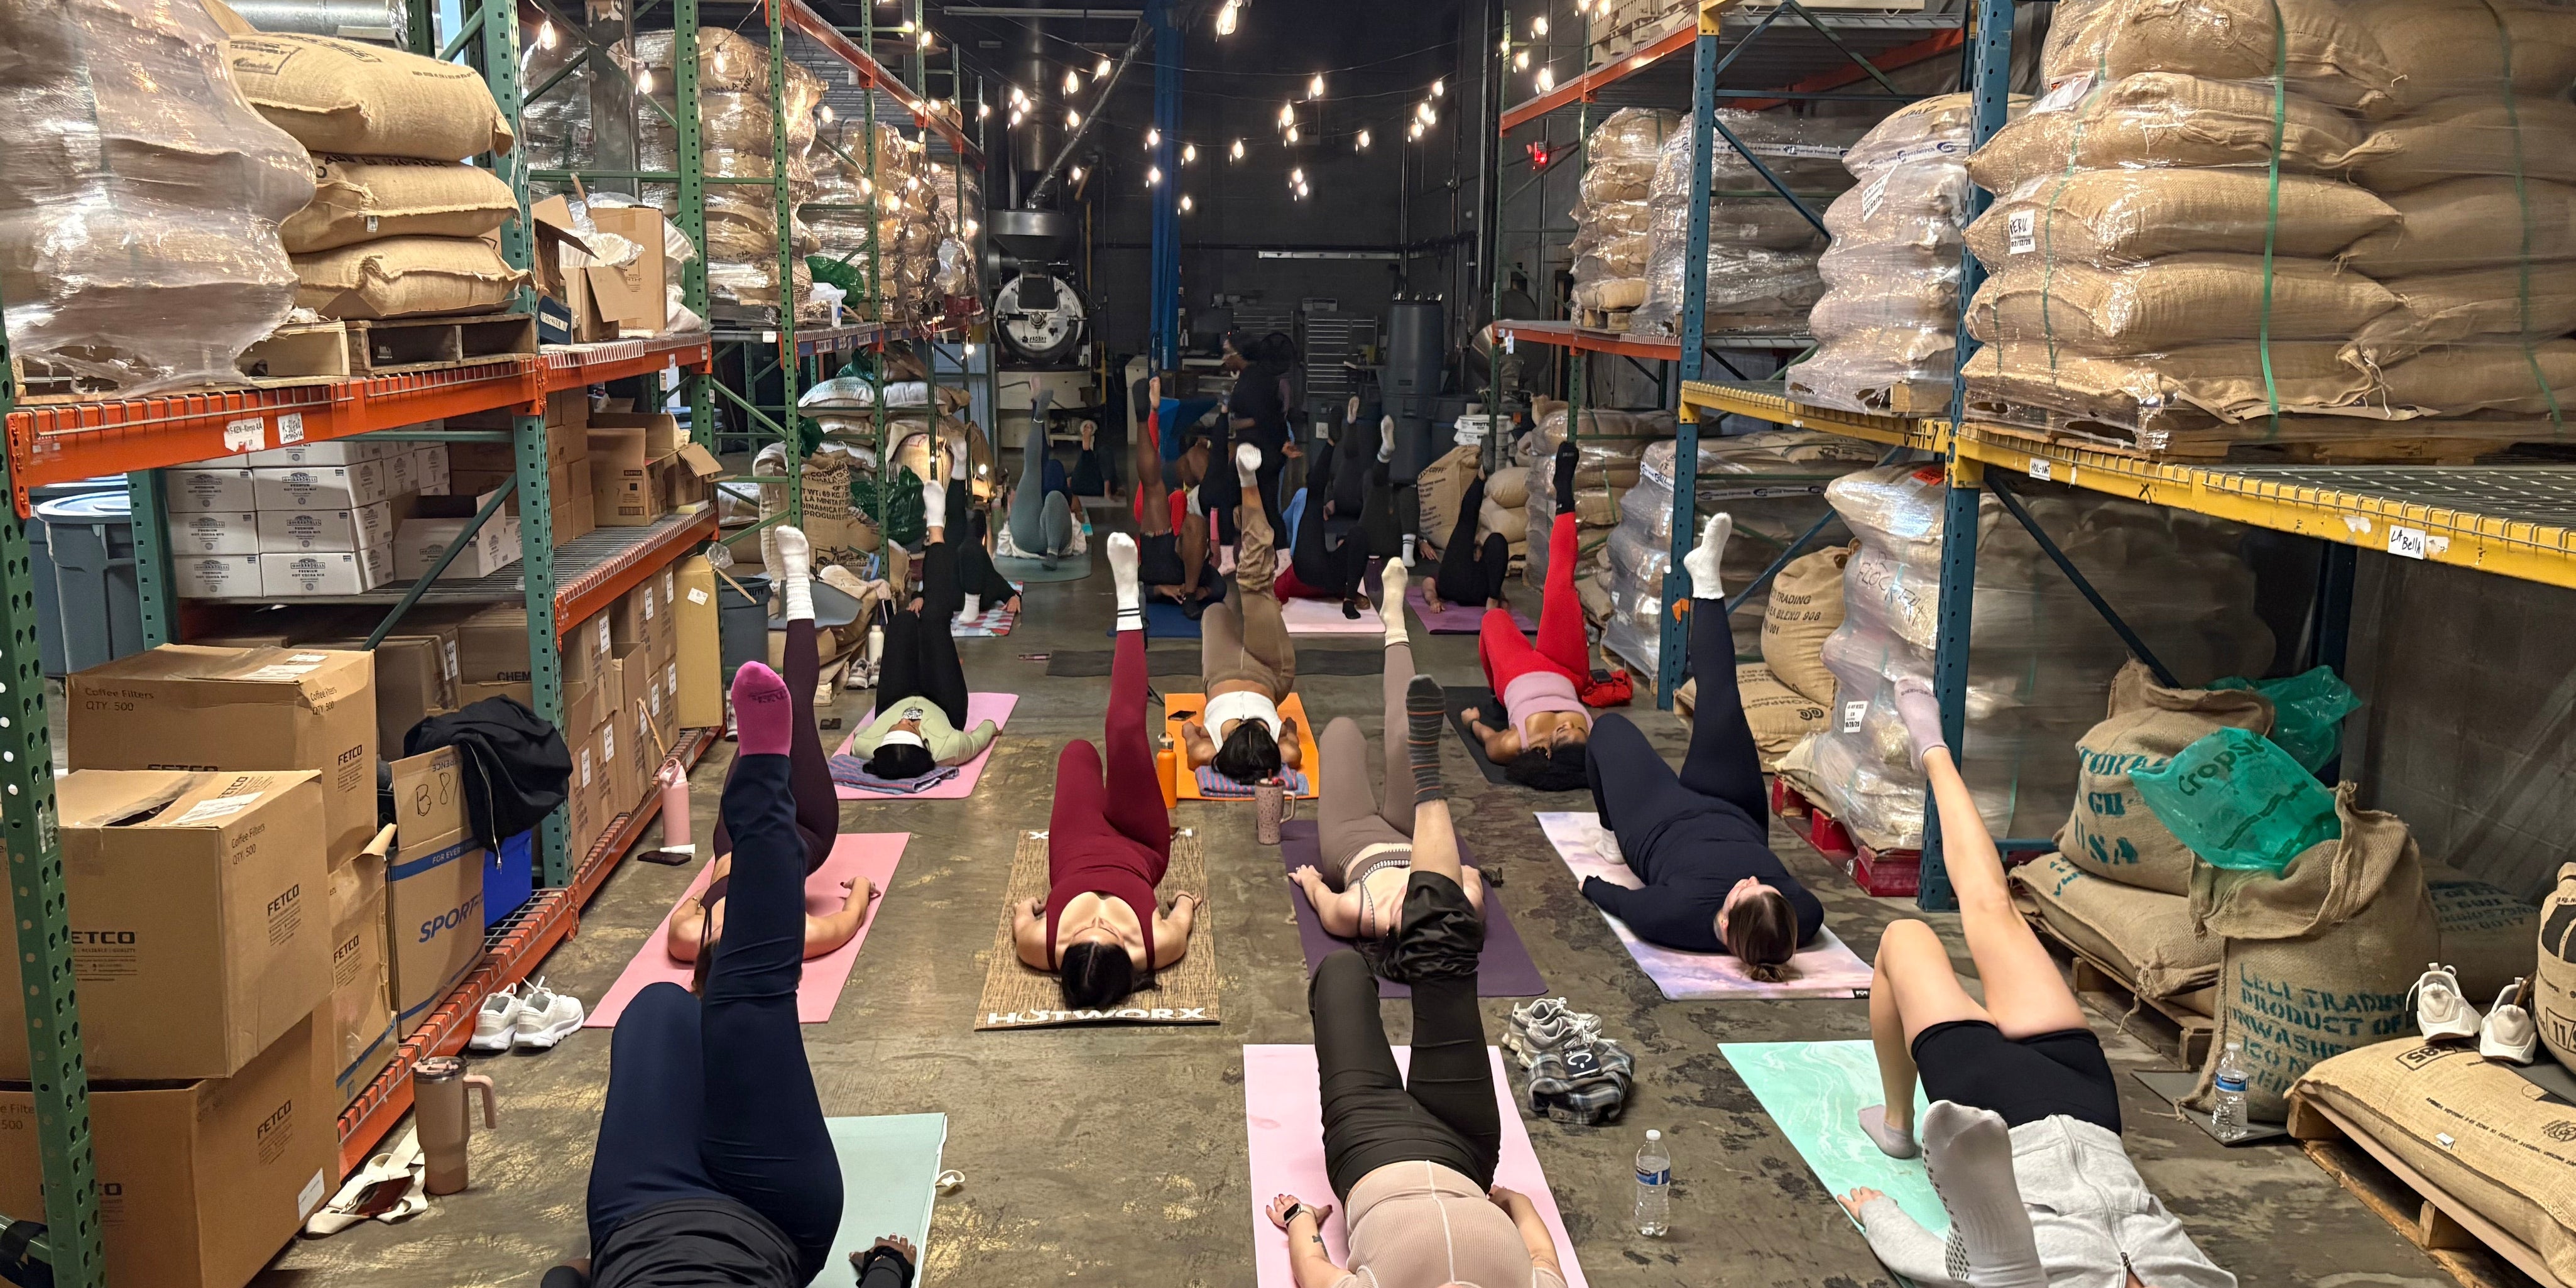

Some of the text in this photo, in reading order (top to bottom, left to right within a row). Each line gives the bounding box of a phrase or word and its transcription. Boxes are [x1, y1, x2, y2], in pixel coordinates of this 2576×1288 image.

[2009, 217, 2028, 235] PERU
[2391, 530, 2403, 542] LA
[1776, 591, 1811, 604] TRADING
[1776, 609, 1801, 621] BLEND
[85, 688, 154, 699] Coffee Filters
[310, 689, 327, 701] Coffee
[114, 701, 134, 711] 500
[325, 701, 335, 712] 500
[338, 745, 363, 766] FETCO
[416, 784, 432, 817] B
[231, 823, 266, 849] Coffee Filters
[2074, 814, 2140, 865] USA
[246, 844, 256, 858] 500
[432, 854, 445, 864] FOR
[268, 884, 300, 916] FETCO
[71, 931, 135, 944] ETCO
[333, 934, 359, 964] FETCO
[2301, 987, 2414, 1013] TRADIN
[987, 1007, 1208, 1025] HOTWORX
[2241, 987, 2402, 1036] PRODUCT OF
[10, 1104, 35, 1114] Filte
[1, 1120, 23, 1130] 500
[258, 1100, 292, 1139] FETCO
